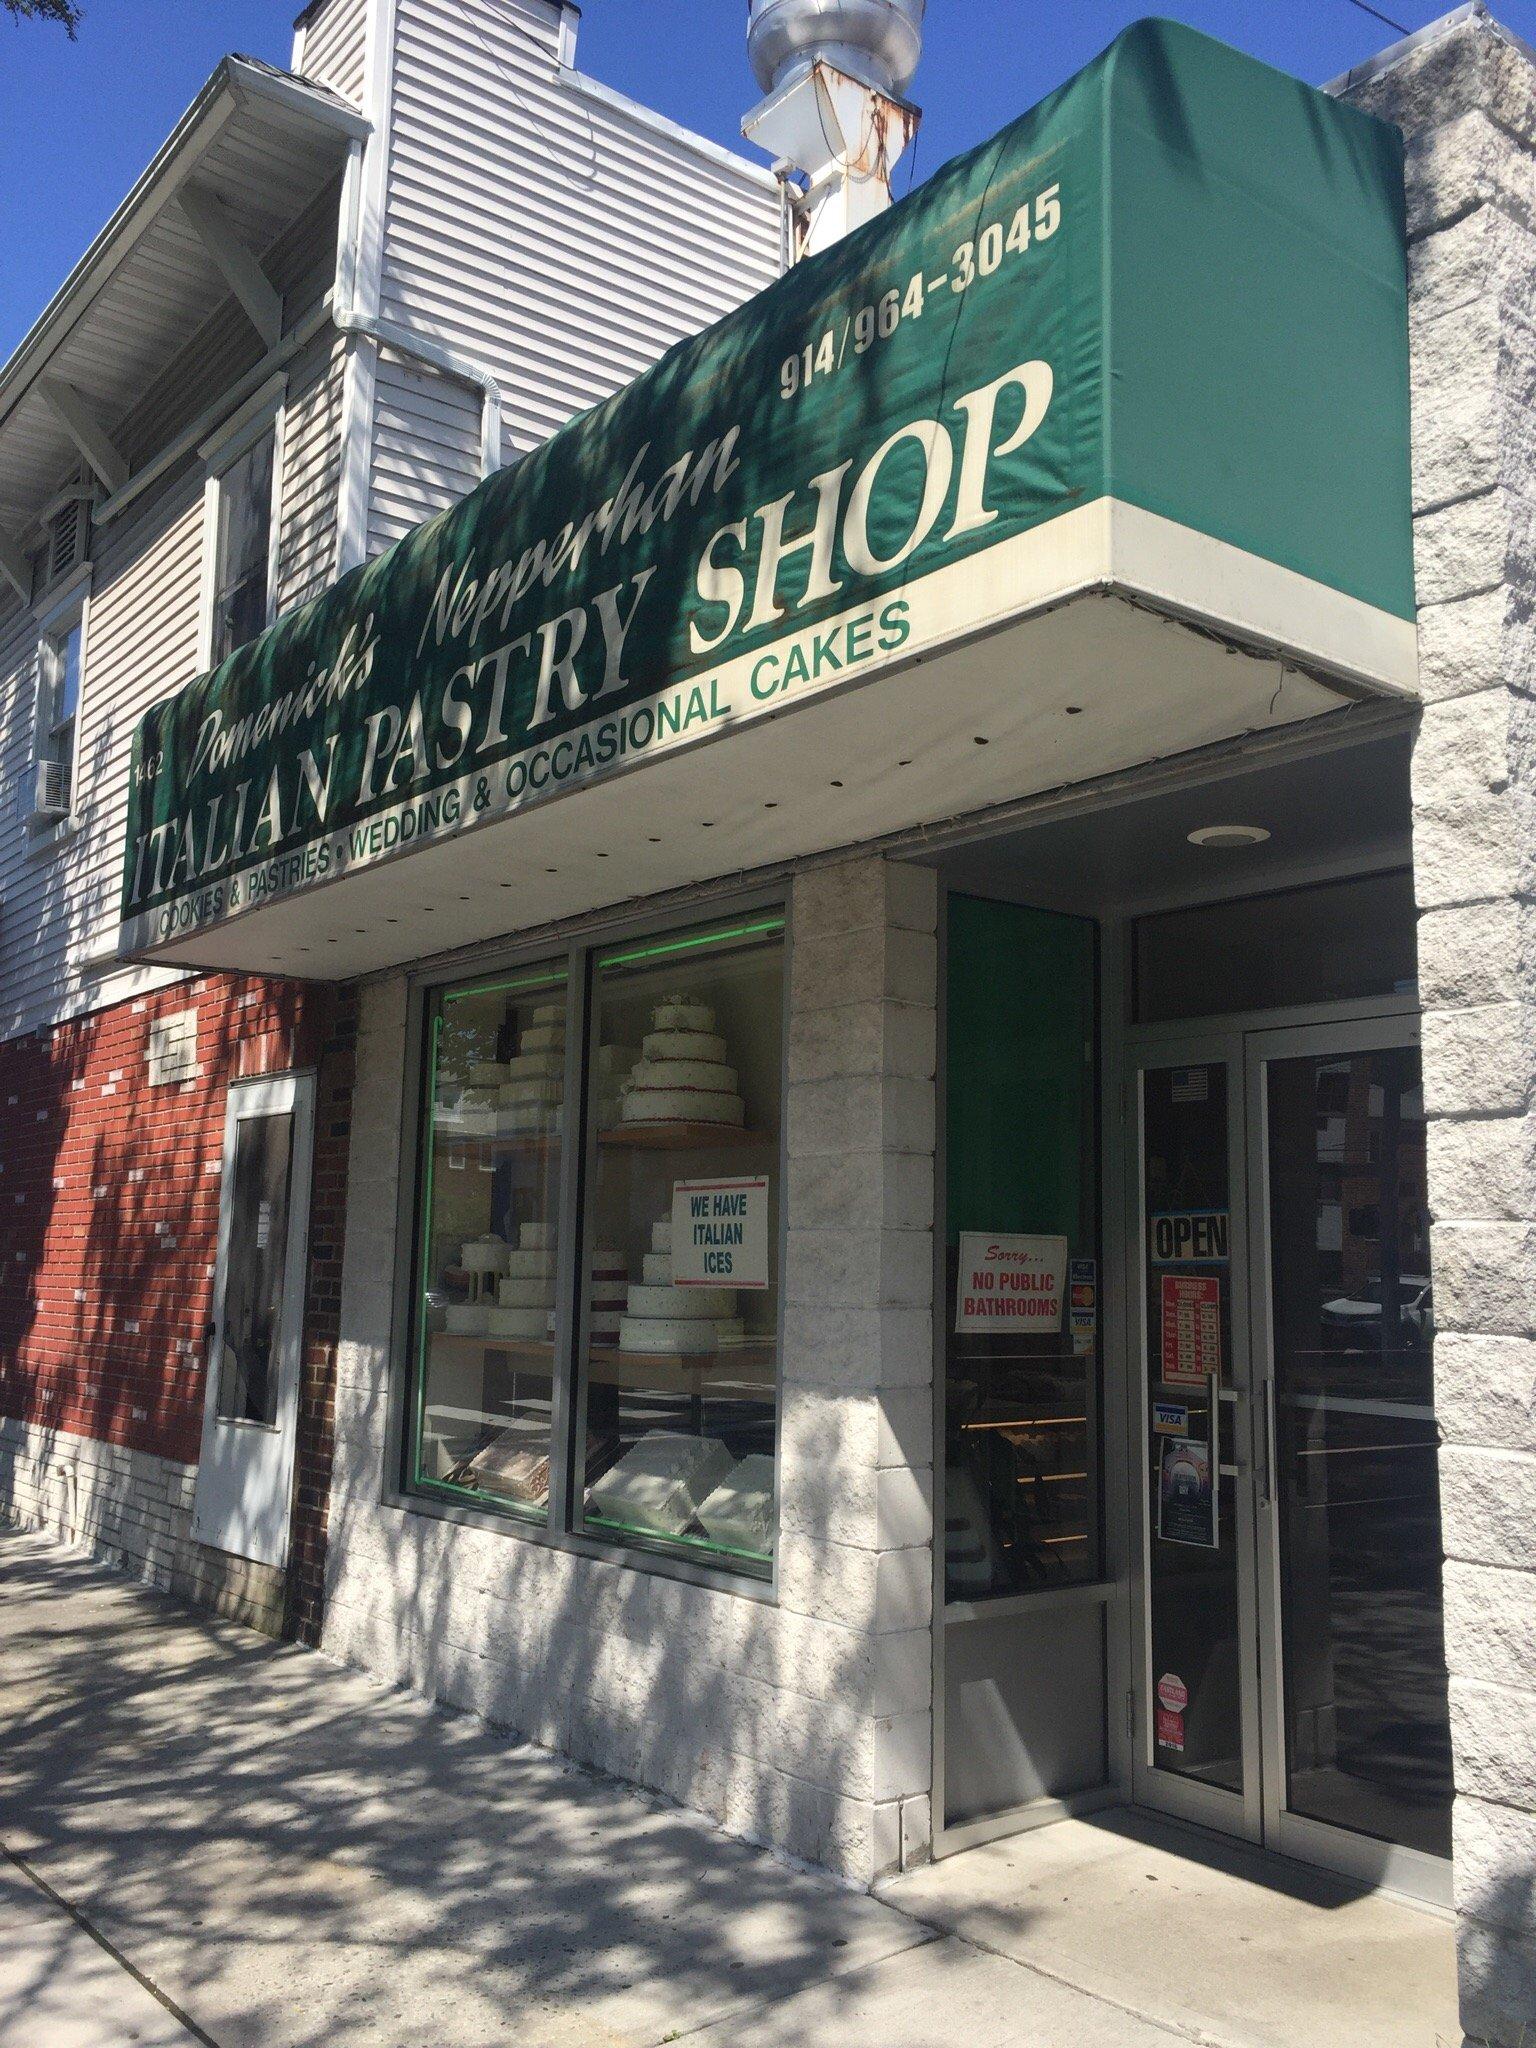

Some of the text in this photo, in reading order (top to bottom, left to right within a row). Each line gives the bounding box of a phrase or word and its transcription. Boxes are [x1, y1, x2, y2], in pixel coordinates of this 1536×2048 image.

[780, 183, 1062, 399] 914/964-3045
[186, 612, 382, 788] Domenick's
[416, 424, 741, 659] Nepperhan
[128, 360, 1054, 904] ITALIAN PASTRY SHOP
[159, 600, 911, 937] COOKIES & PASTRIES WEDDING & OCCASIONAL CAKES
[691, 1194, 747, 1217] WE HAVE
[693, 1223, 743, 1245] ITALIAN
[1156, 1215, 1227, 1259] OPEN
[704, 1252, 733, 1273] ICES
[984, 1245, 1044, 1264] Sorry...
[972, 1272, 1055, 1292] NO PUBLIC
[963, 1297, 1058, 1317] BATHROOMS
[1159, 1413, 1182, 1426] VISA
